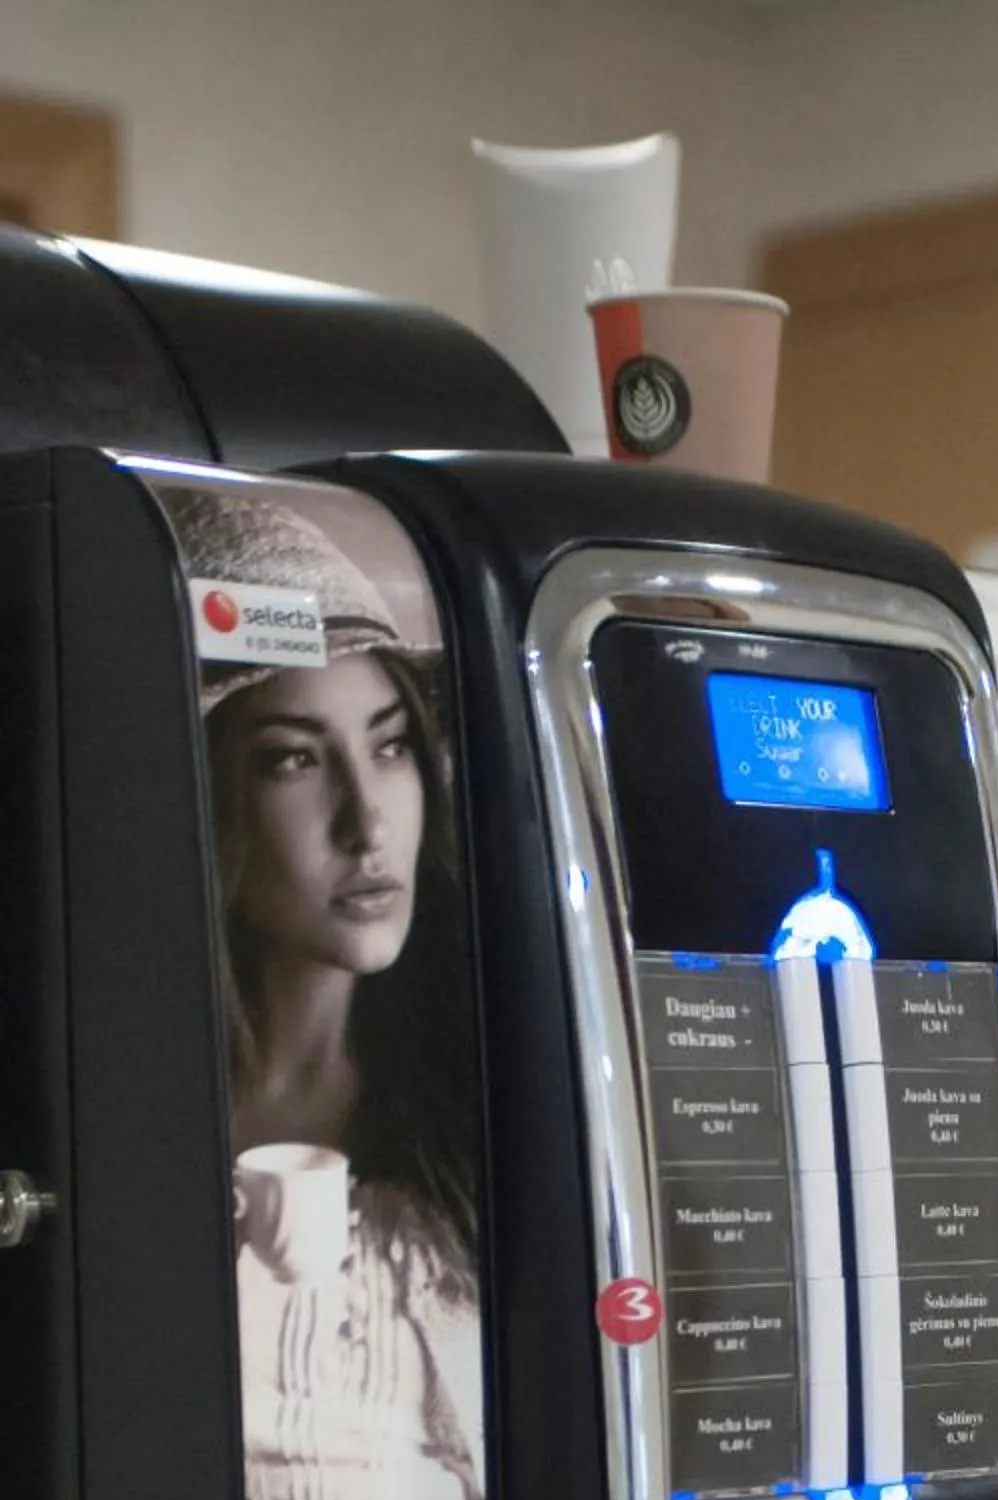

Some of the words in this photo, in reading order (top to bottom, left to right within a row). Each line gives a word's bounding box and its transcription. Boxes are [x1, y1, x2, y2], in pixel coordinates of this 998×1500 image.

[242, 605, 317, 631] selecta
[795, 696, 838, 721] YOUR
[729, 1096, 759, 1115] kava
[743, 1206, 773, 1223] kava
[953, 1201, 979, 1217] kava
[616, 1286, 655, 1321] 3
[752, 1315, 782, 1330] kava
[744, 1414, 772, 1431] kava
